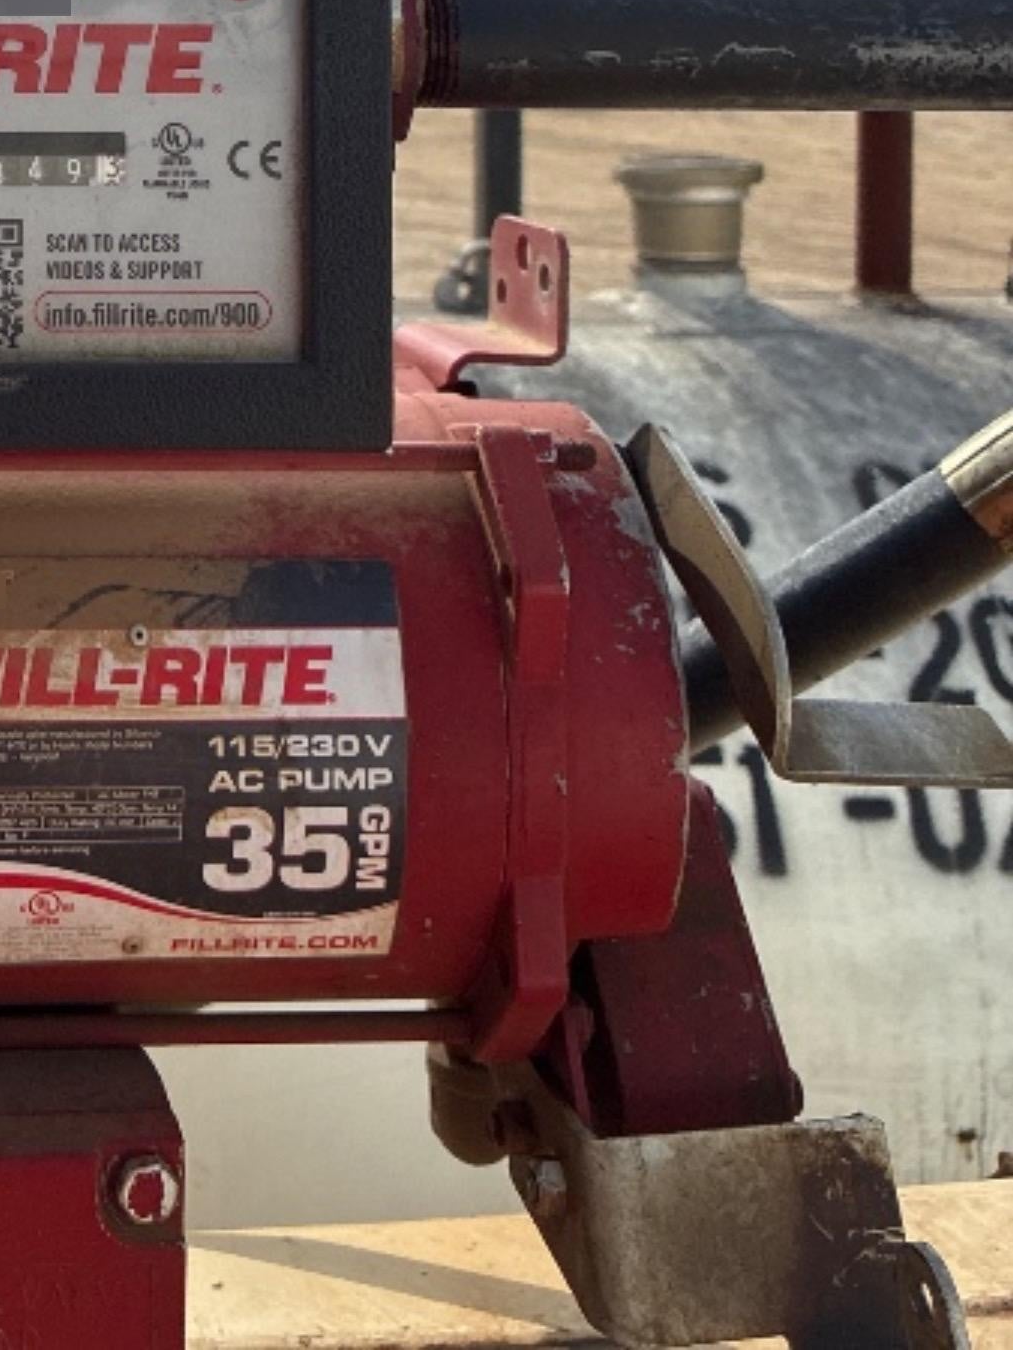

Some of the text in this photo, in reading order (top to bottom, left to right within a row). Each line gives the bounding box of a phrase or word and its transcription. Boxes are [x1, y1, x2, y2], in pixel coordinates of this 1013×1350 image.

[46, 233, 181, 253] SCAN TO ACCESS
[46, 260, 203, 280] VIDEOS & SUPPORT
[44, 302, 260, 328] info.fillrite.com/900
[208, 767, 394, 793] AC PUMP
[201, 805, 352, 893] 35
[354, 803, 392, 891] GPM
[168, 933, 380, 952] FILLRITE.COM
